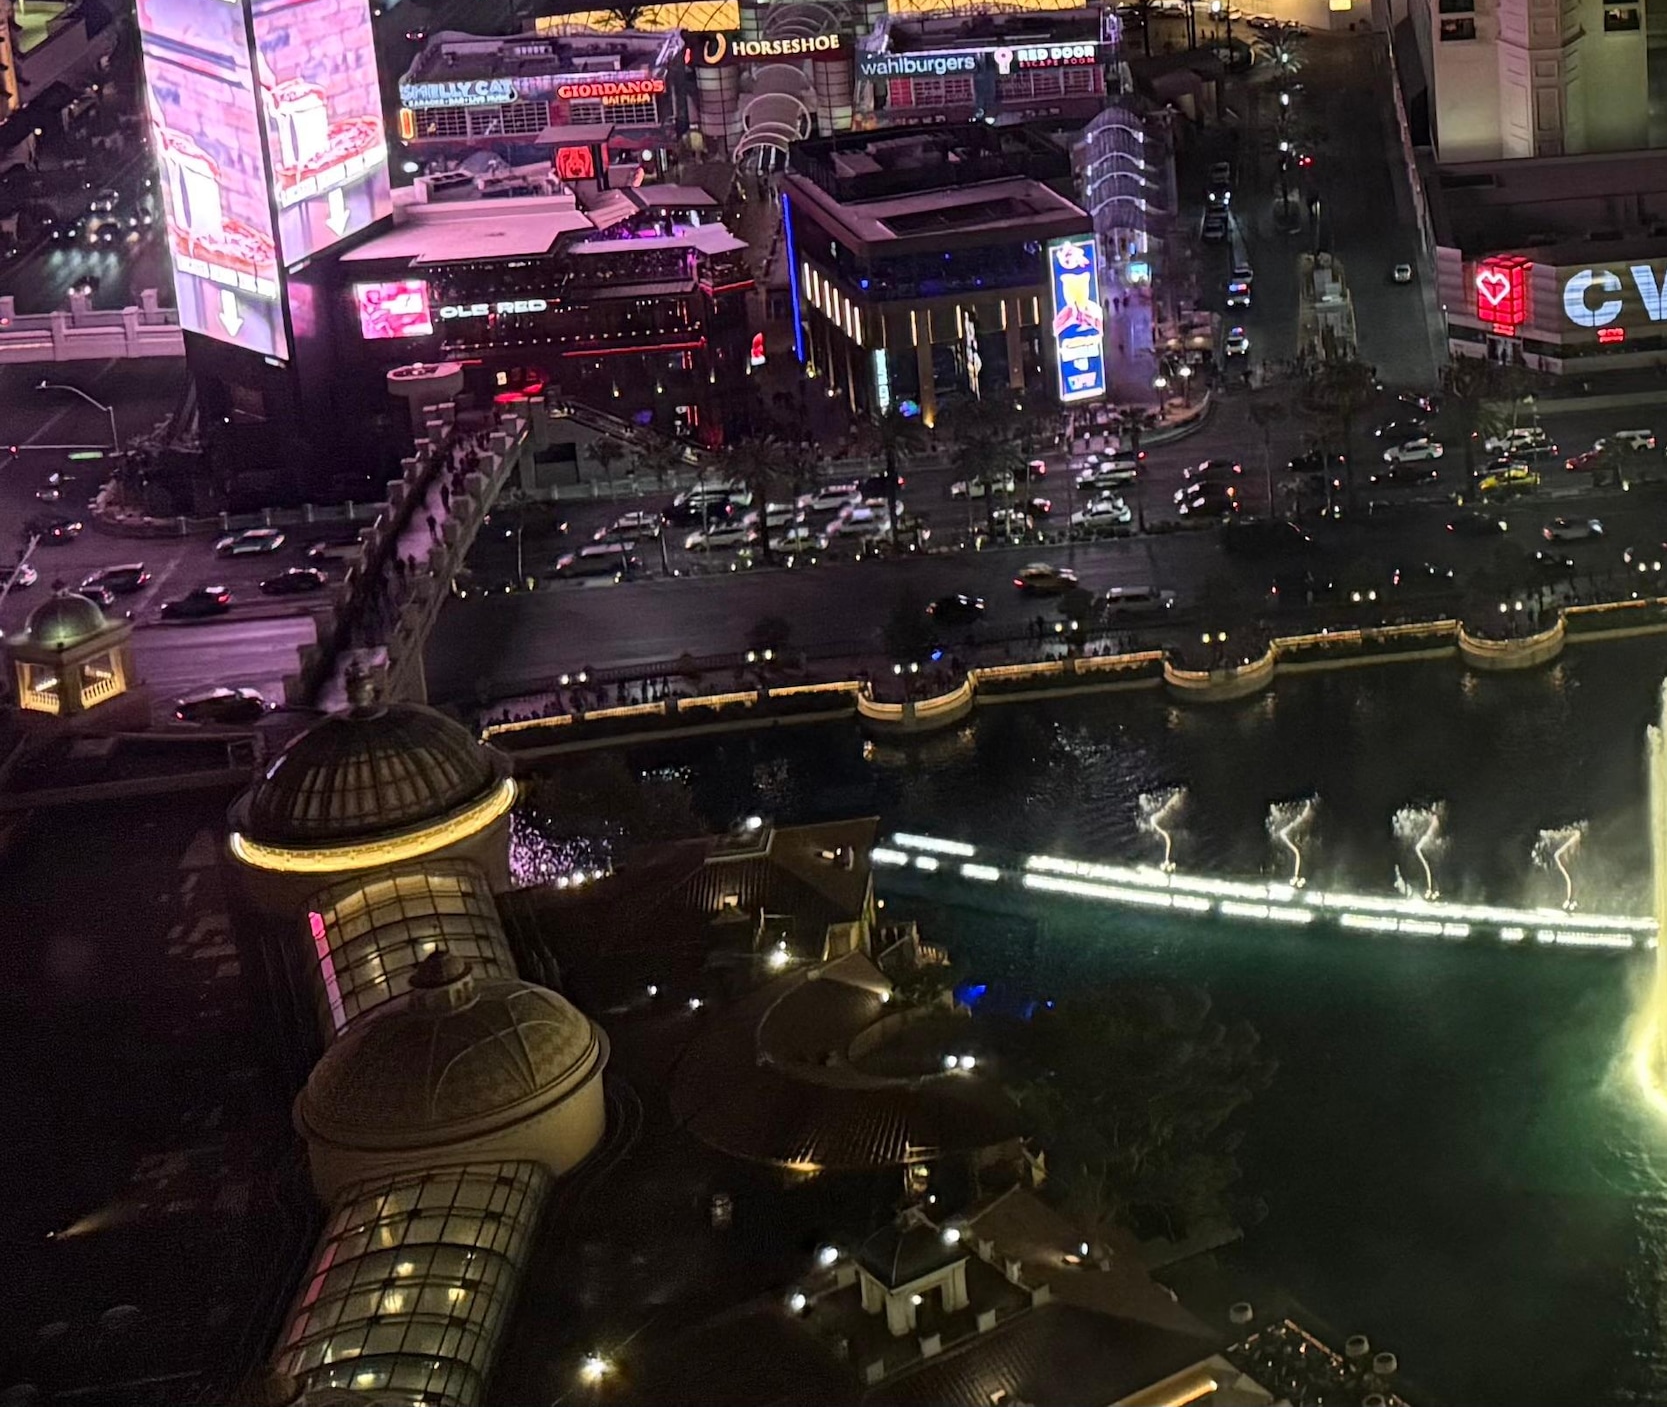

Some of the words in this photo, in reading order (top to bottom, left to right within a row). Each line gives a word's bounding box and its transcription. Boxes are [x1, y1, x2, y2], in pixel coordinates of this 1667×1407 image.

[732, 34, 840, 56] HORSESHOE
[1018, 48, 1048, 61] RED
[1051, 46, 1095, 61] DOOR
[860, 55, 976, 75] wahlburgers
[1019, 59, 1059, 68] ESCAPE
[1064, 57, 1096, 66] ROOM
[475, 78, 513, 96] CAT
[557, 78, 665, 99] GIORDANO'S
[440, 303, 490, 318] OLE
[497, 299, 548, 315] RED
